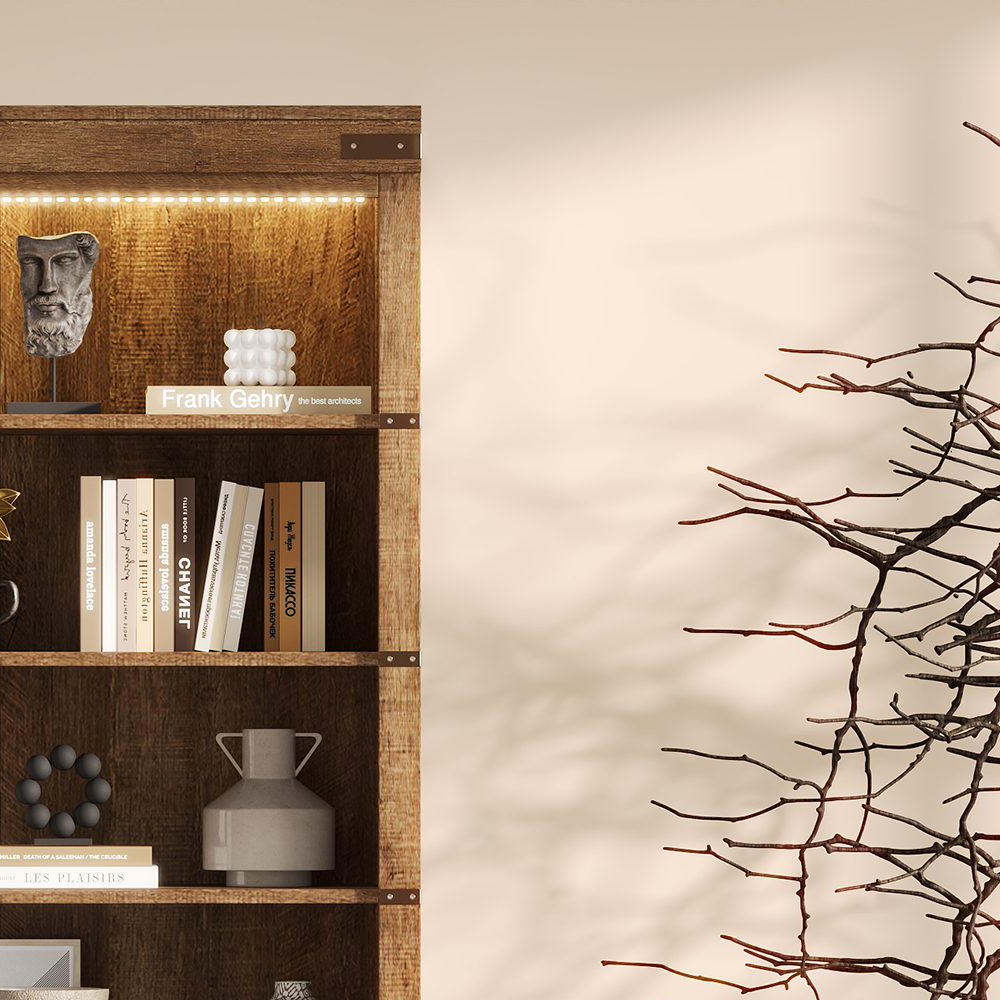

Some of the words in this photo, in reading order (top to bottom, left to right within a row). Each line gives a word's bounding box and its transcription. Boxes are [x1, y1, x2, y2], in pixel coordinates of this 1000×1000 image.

[162, 389, 222, 408] Frank
[230, 389, 294, 413] Gehry
[86, 521, 97, 564] amanda
[86, 566, 97, 611] lovelace
[285, 568, 296, 617] ПИКАССО
[24, 873, 50, 883] LES
[57, 873, 125, 883] PLAISIRS
